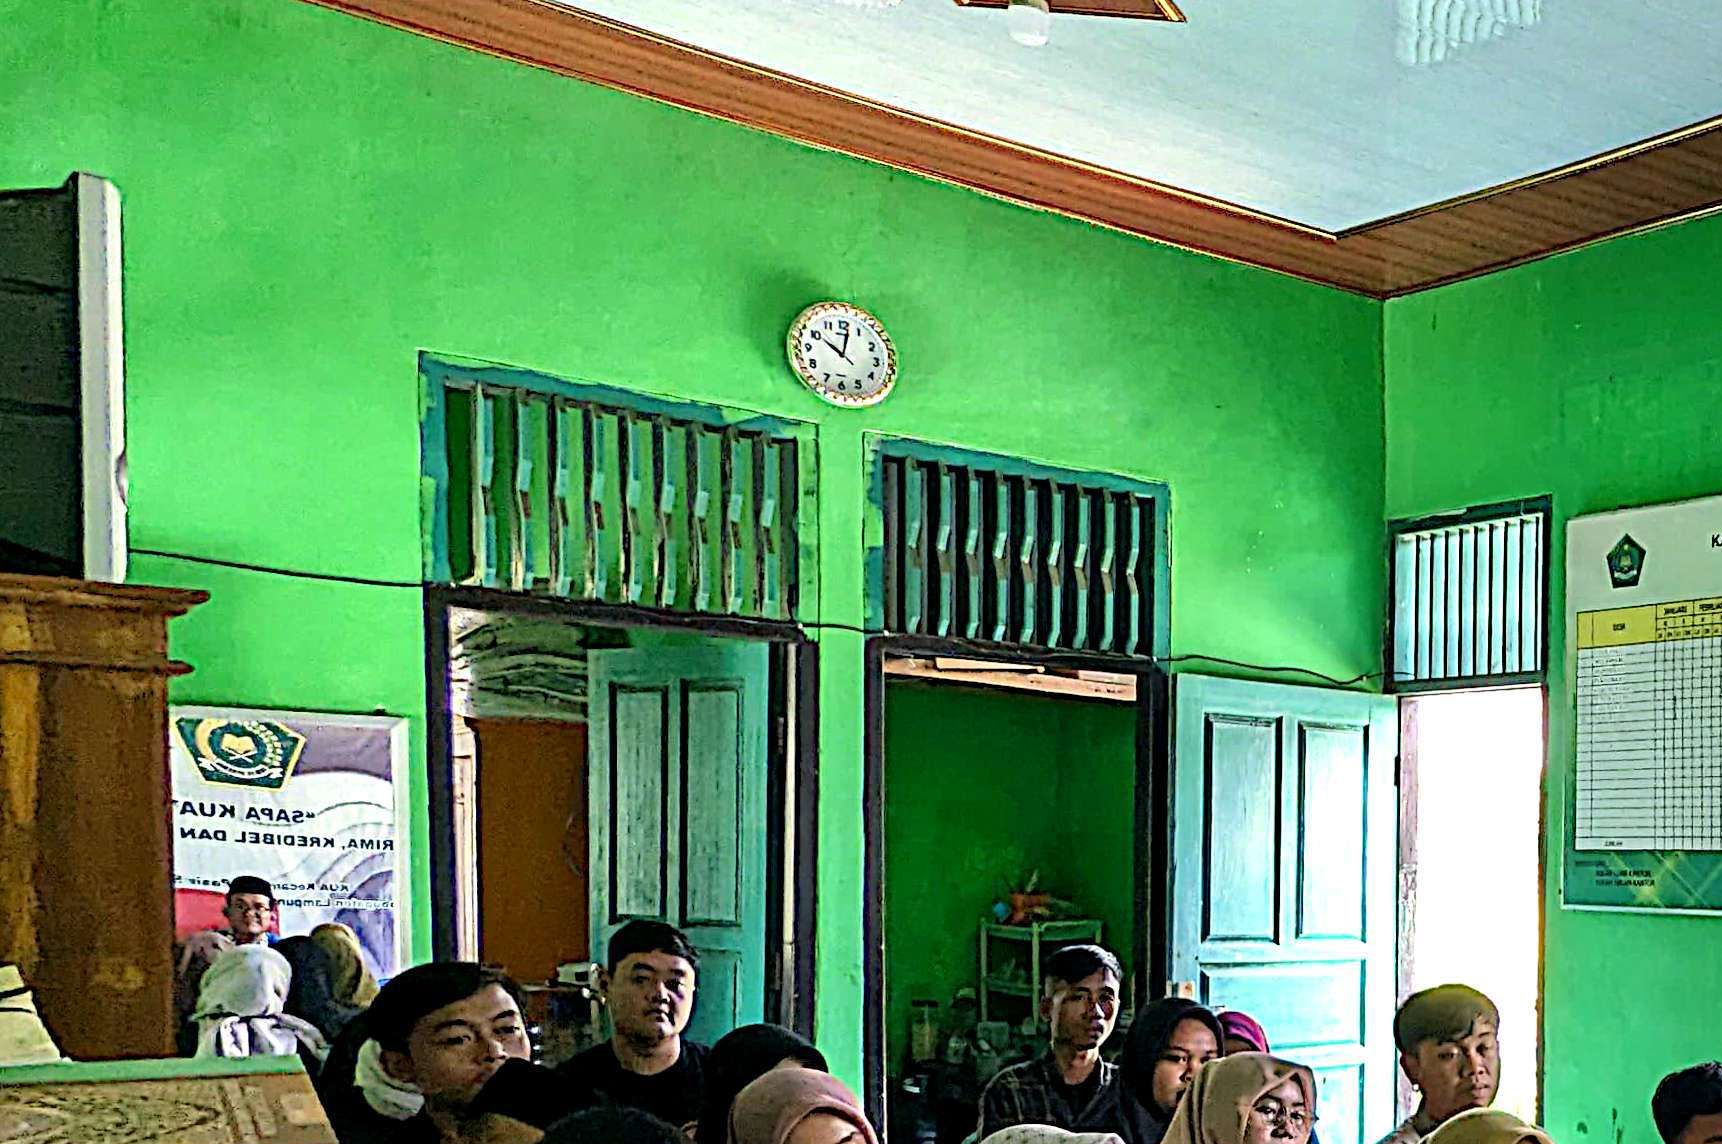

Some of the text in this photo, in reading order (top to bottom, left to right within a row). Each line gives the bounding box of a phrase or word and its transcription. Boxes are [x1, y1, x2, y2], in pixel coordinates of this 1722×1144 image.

[824, 321, 833, 331] 11
[811, 330, 821, 341] 10
[856, 328, 861, 337] 1
[804, 343, 812, 353] 9
[868, 341, 876, 352] 2
[809, 359, 817, 369] 8
[872, 357, 880, 367] 3
[823, 373, 831, 383] 7
[867, 371, 874, 381] 4
[838, 381, 846, 390] 6
[854, 379, 862, 389] 5
